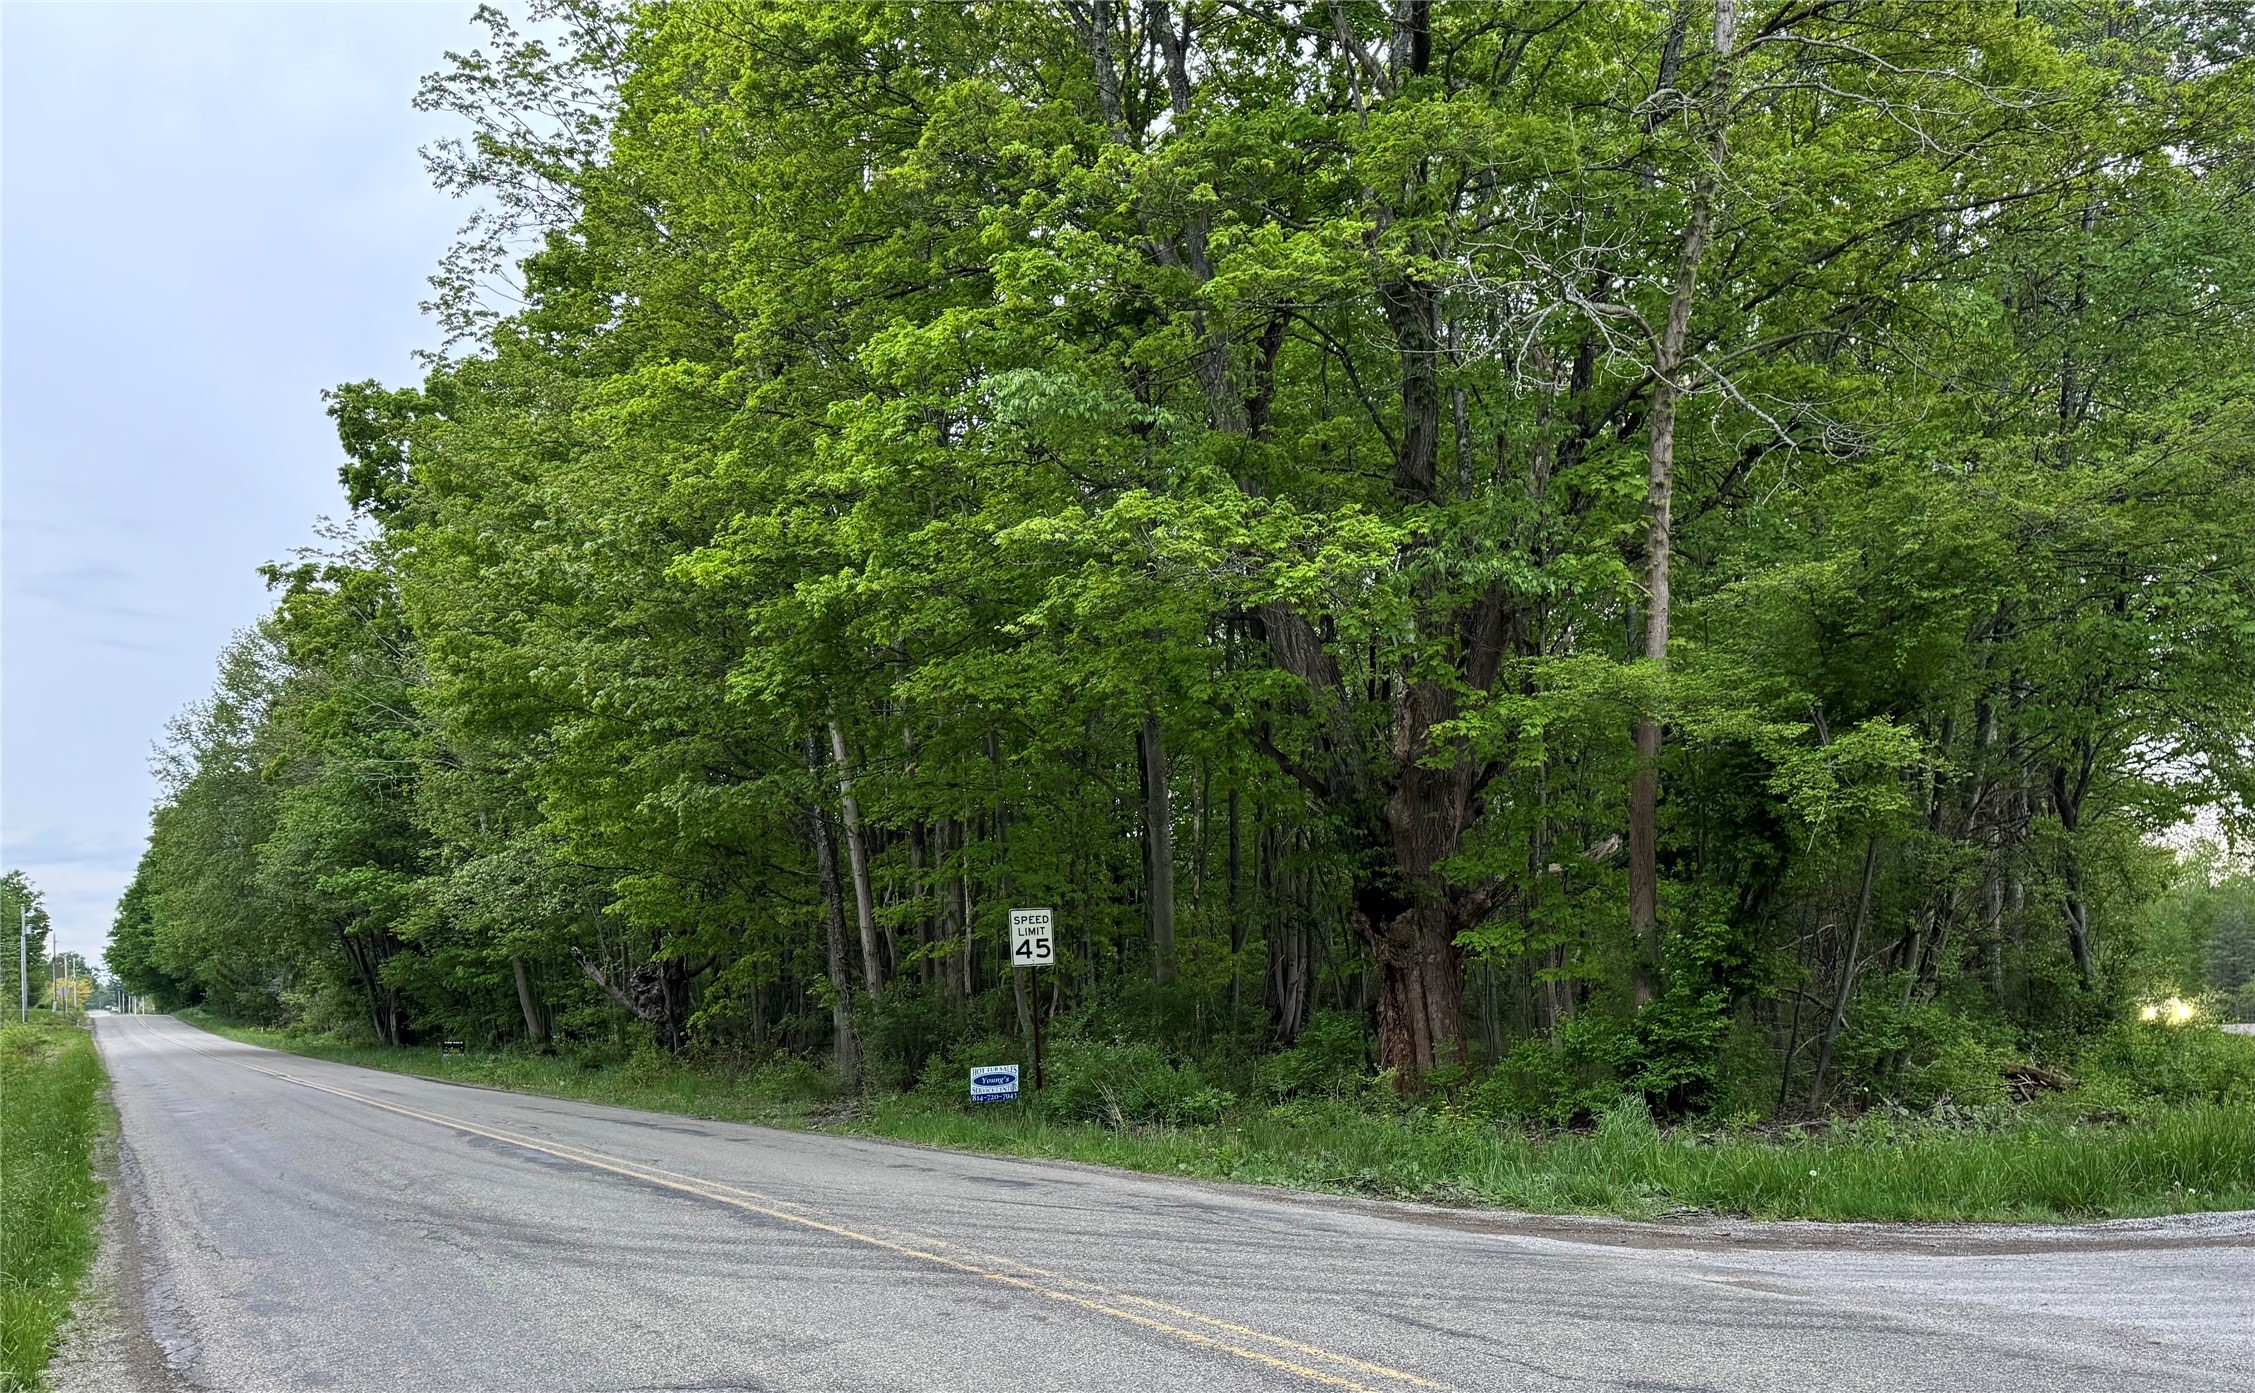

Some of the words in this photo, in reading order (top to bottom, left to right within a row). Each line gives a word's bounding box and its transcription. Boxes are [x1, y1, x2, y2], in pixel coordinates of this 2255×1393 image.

[1013, 915, 1049, 924] SPEED
[1018, 927, 1045, 936] LIMIT
[1015, 938, 1051, 959] 45
[972, 1068, 985, 1077] HOT
[981, 1076, 1010, 1084] Young's
[995, 1083, 1018, 1092] CENTER
